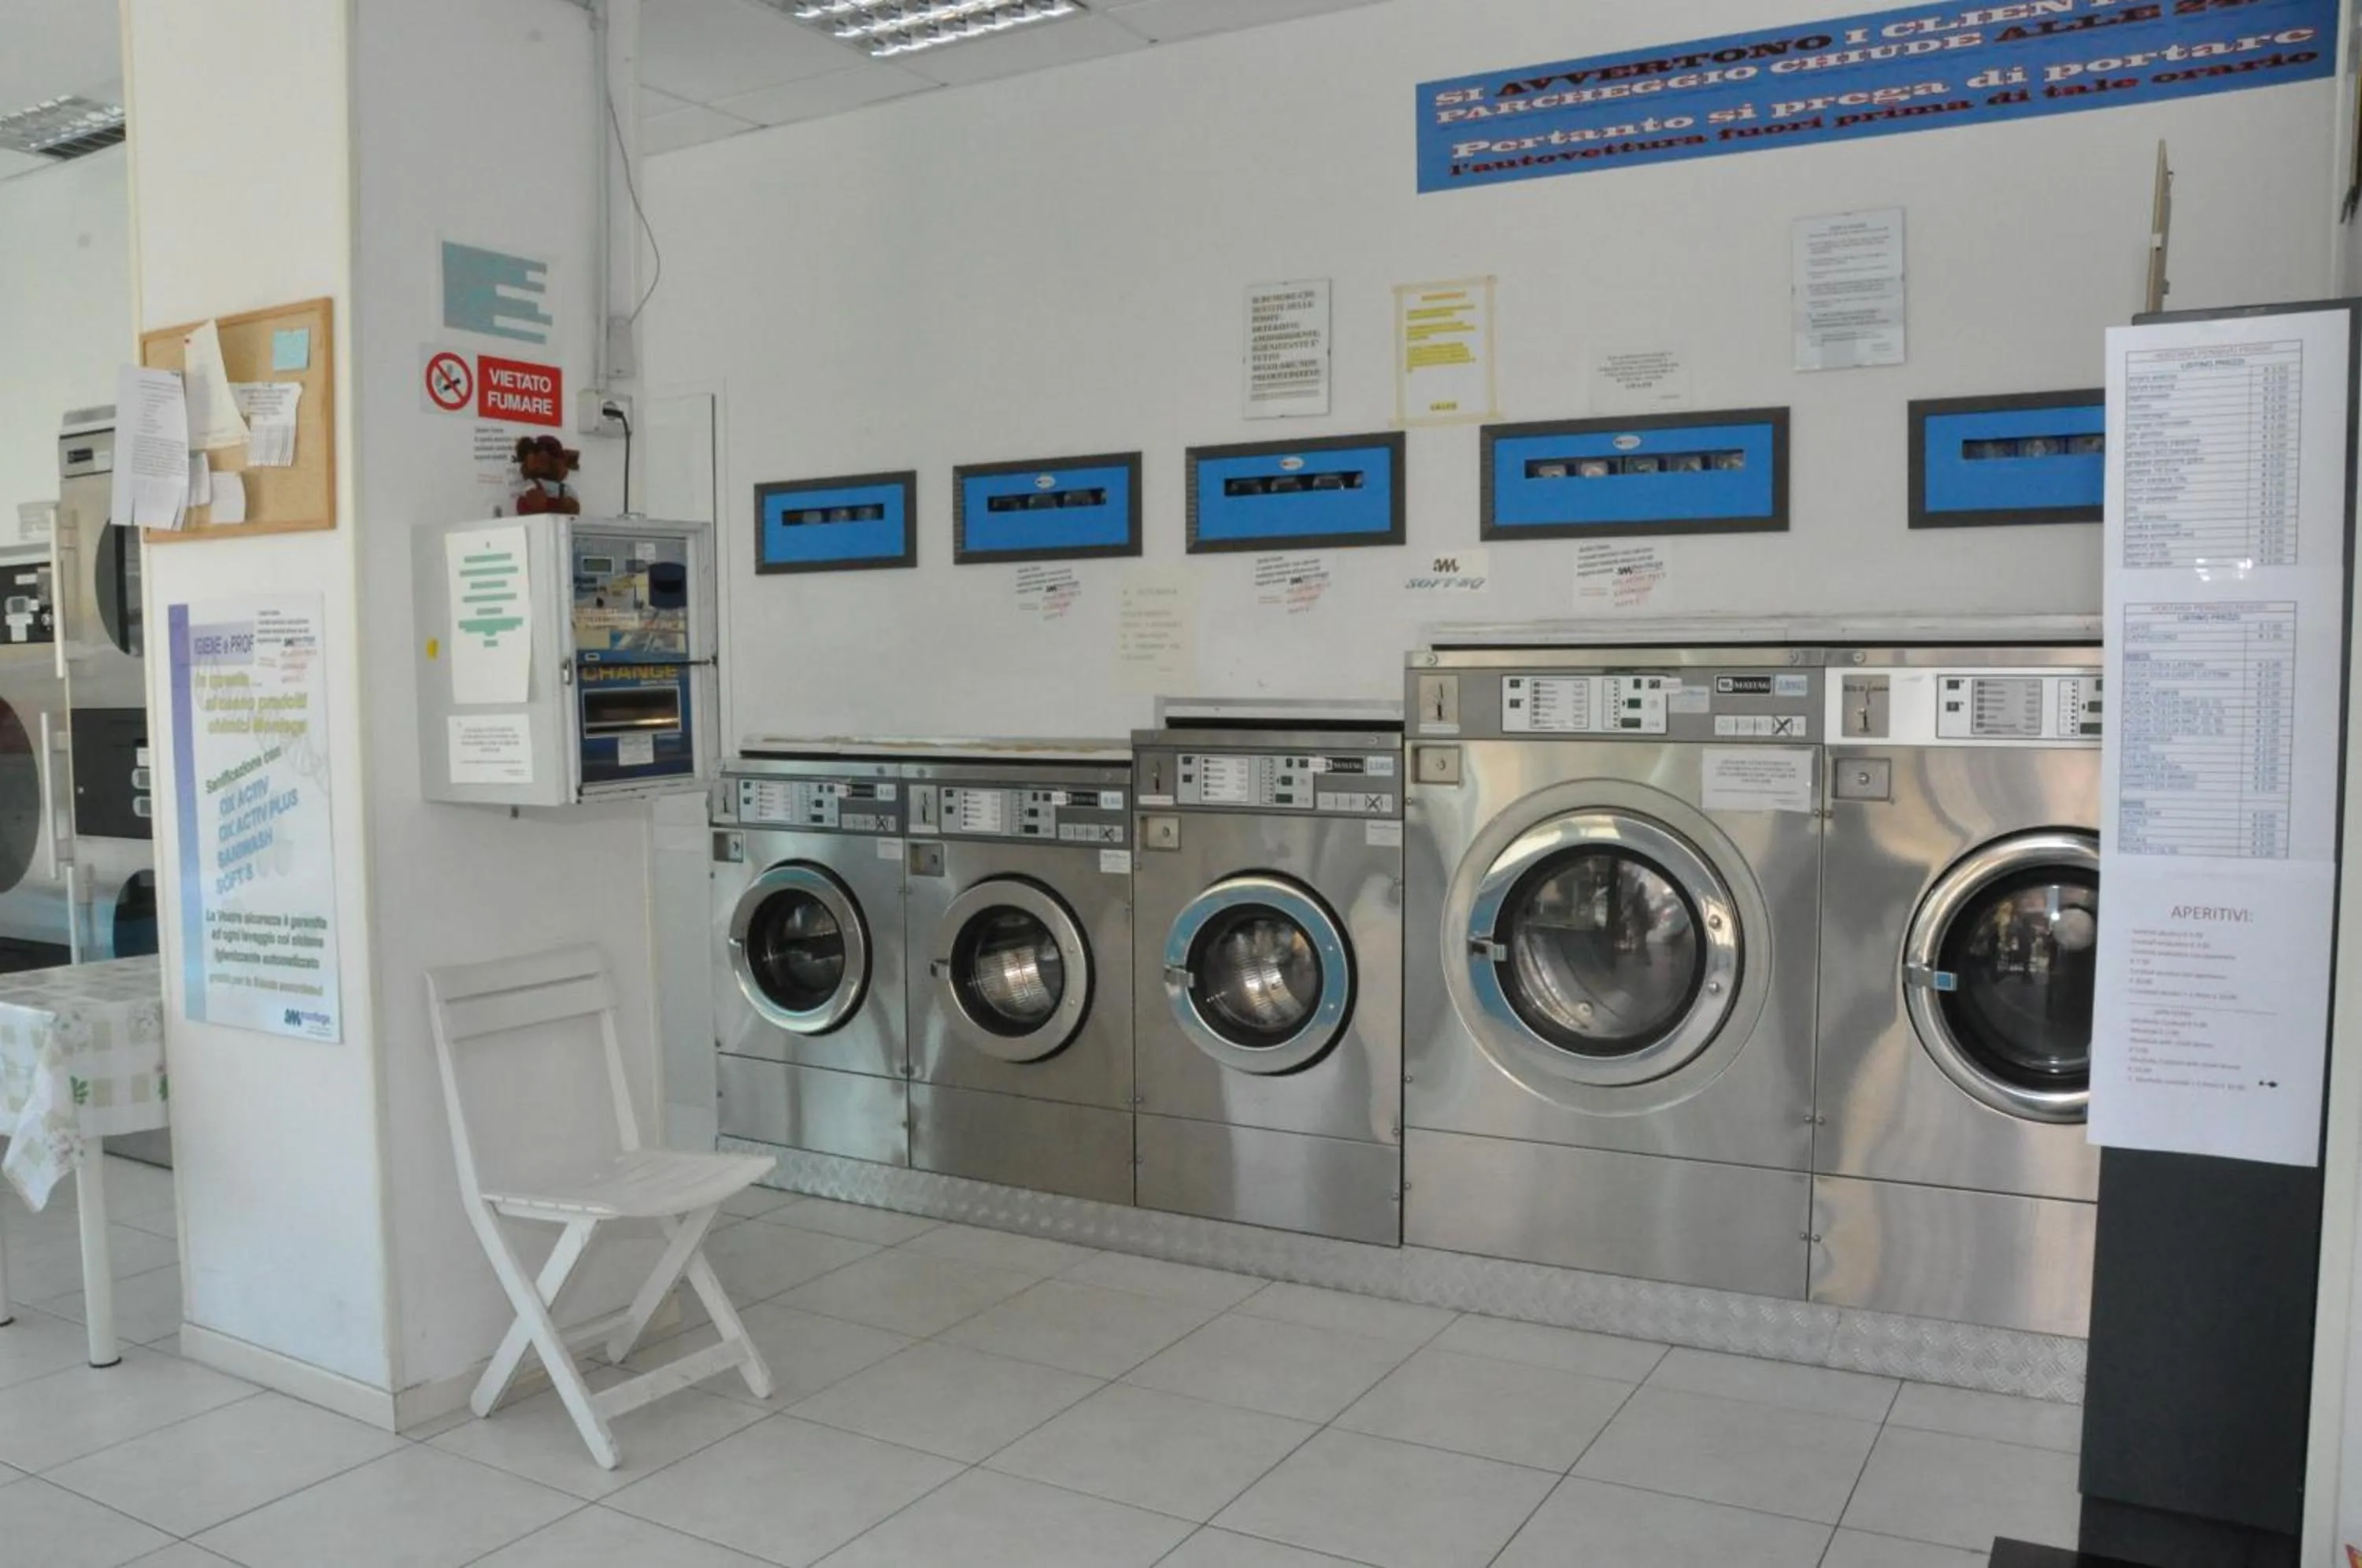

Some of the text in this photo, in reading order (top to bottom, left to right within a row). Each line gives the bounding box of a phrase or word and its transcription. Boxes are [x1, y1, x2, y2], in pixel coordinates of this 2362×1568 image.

[1435, 0, 2116, 106] SI AVVERTONO I CLIEN
[1437, 4, 2160, 124] PARCHEGGIO CHIUDE ALLE
[1453, 28, 2314, 158] Pertanto si prega di portare
[1450, 135, 1707, 176] l'autovettura
[1718, 117, 1823, 141] fuori
[1986, 88, 2030, 105] di
[2042, 78, 2138, 98] tale
[2150, 52, 2319, 83] orario
[489, 368, 551, 394] VIETATO
[488, 391, 553, 416] FUMARE
[194, 636, 221, 655] IGIENE
[582, 665, 680, 681] CHANGE
[237, 775, 269, 809] ACTIV
[268, 788, 298, 819] PLUS
[2171, 906, 2254, 923] APERITIVI:
